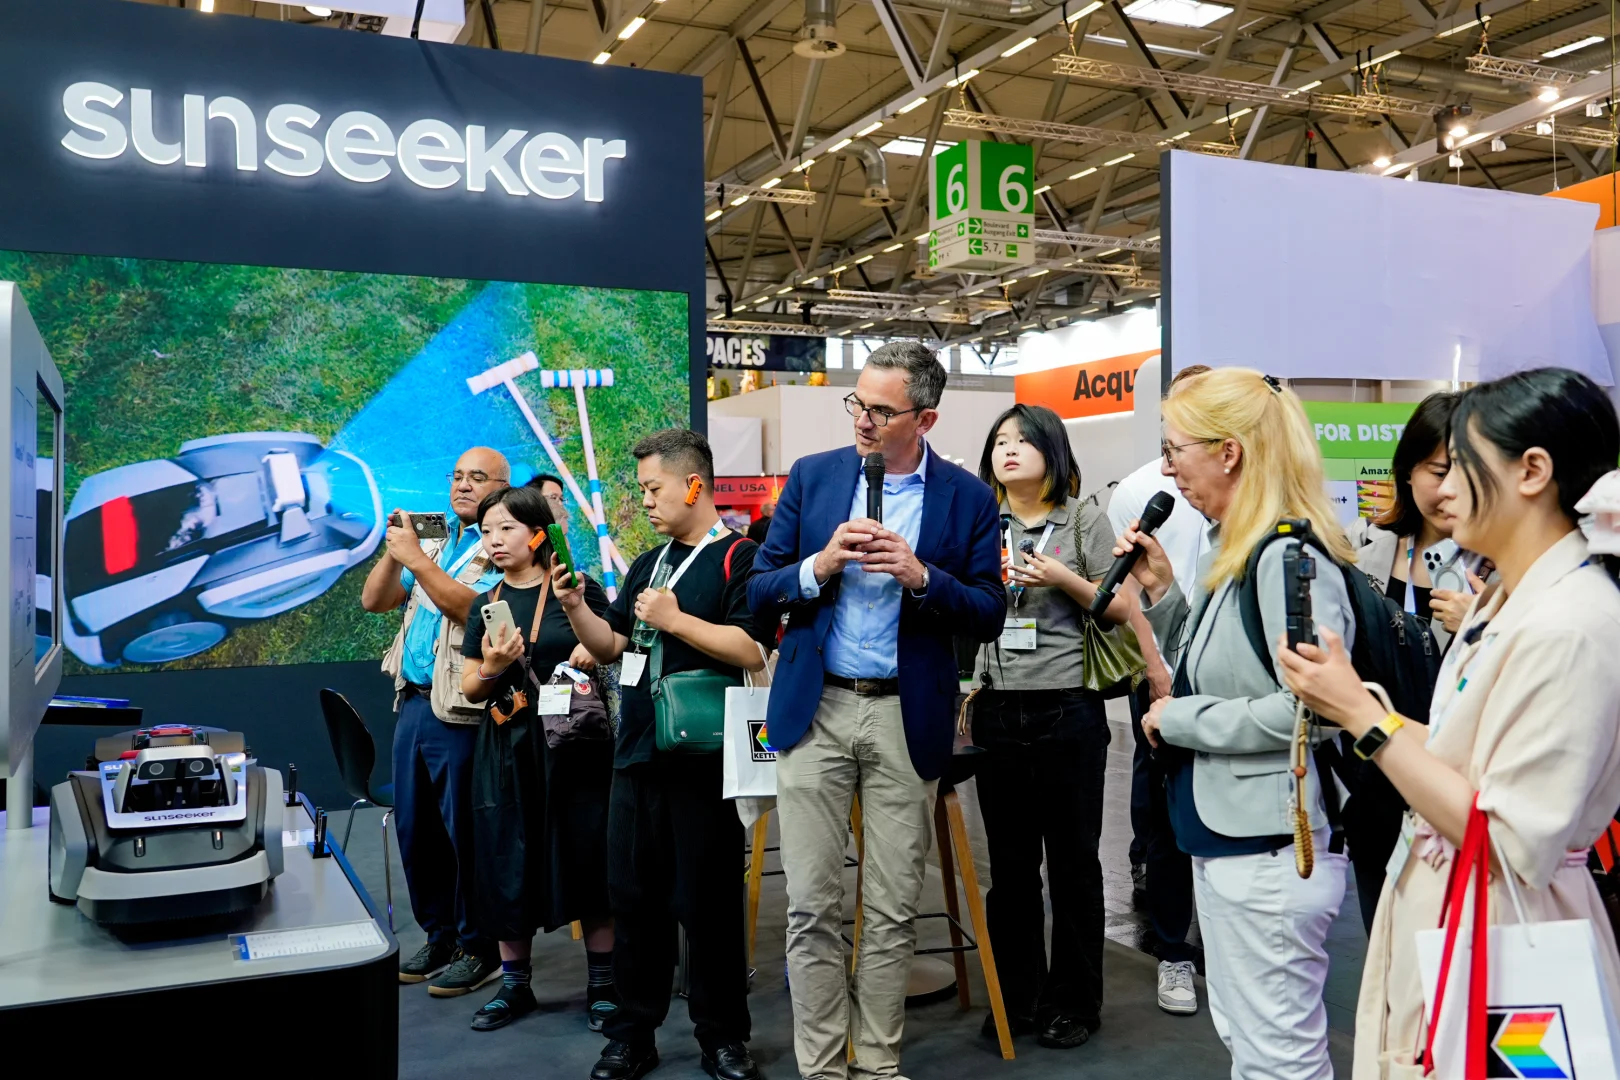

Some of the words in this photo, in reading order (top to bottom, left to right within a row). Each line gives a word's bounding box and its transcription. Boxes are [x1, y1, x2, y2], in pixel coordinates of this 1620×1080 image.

[61, 81, 627, 202] sunseeker
[946, 163, 965, 214] 6
[998, 164, 1028, 213] 6
[1314, 423, 1352, 441] FOR
[1357, 424, 1406, 442] DIST
[740, 483, 767, 492] USA
[144, 811, 216, 822] sunseeker
